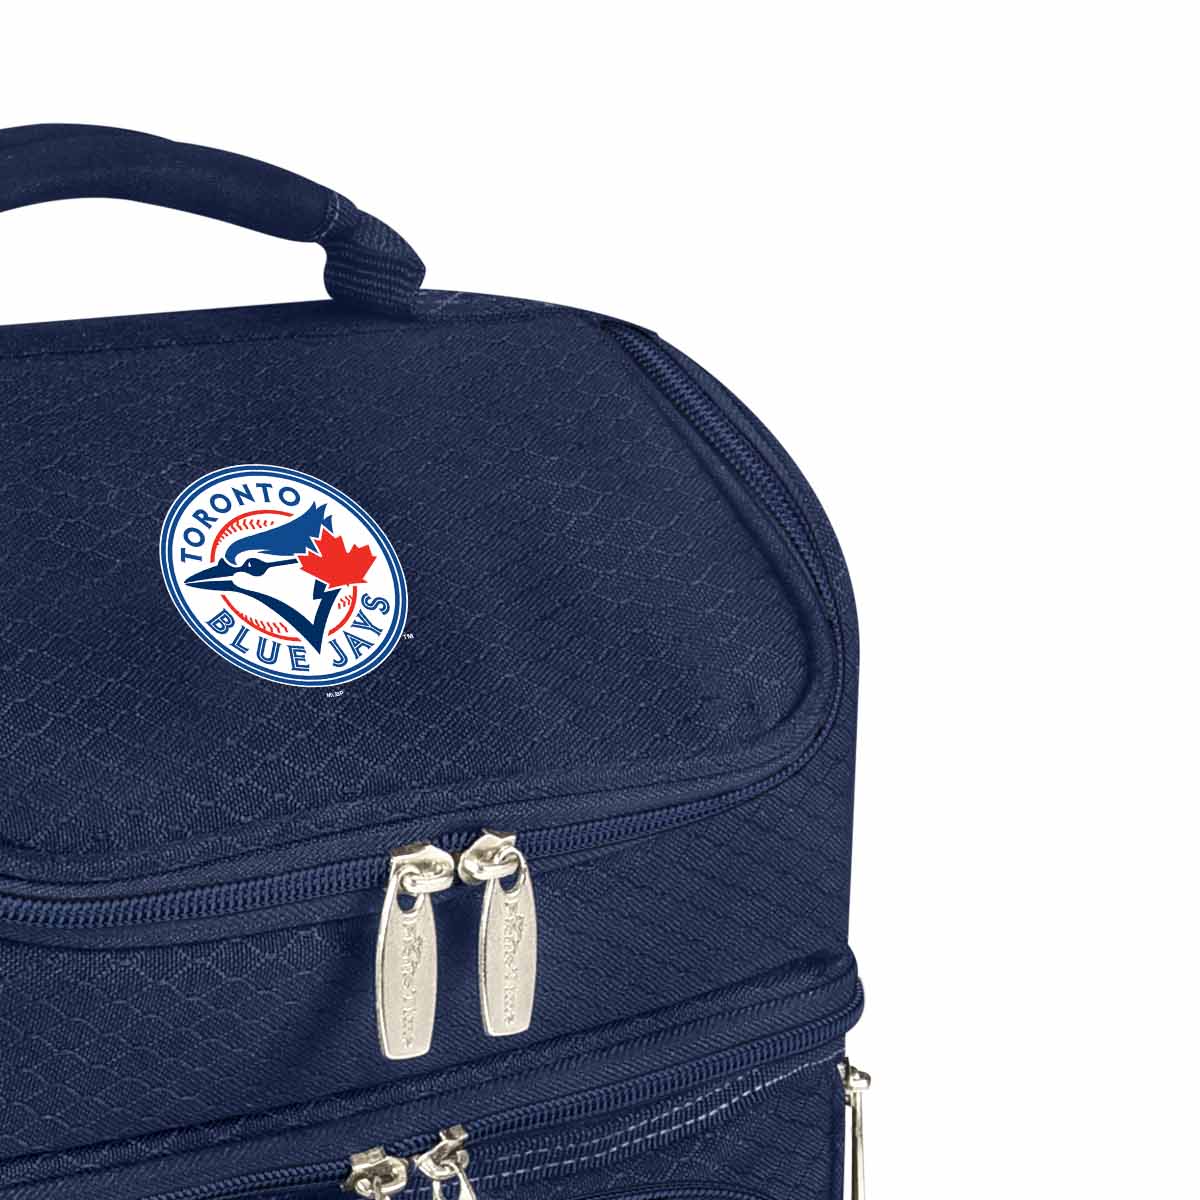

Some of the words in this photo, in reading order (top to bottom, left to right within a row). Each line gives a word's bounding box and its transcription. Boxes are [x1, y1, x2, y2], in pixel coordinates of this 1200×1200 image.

[180, 482, 301, 563] TORONTO
[206, 608, 310, 672] BLUE
[327, 592, 391, 668] JAYS
